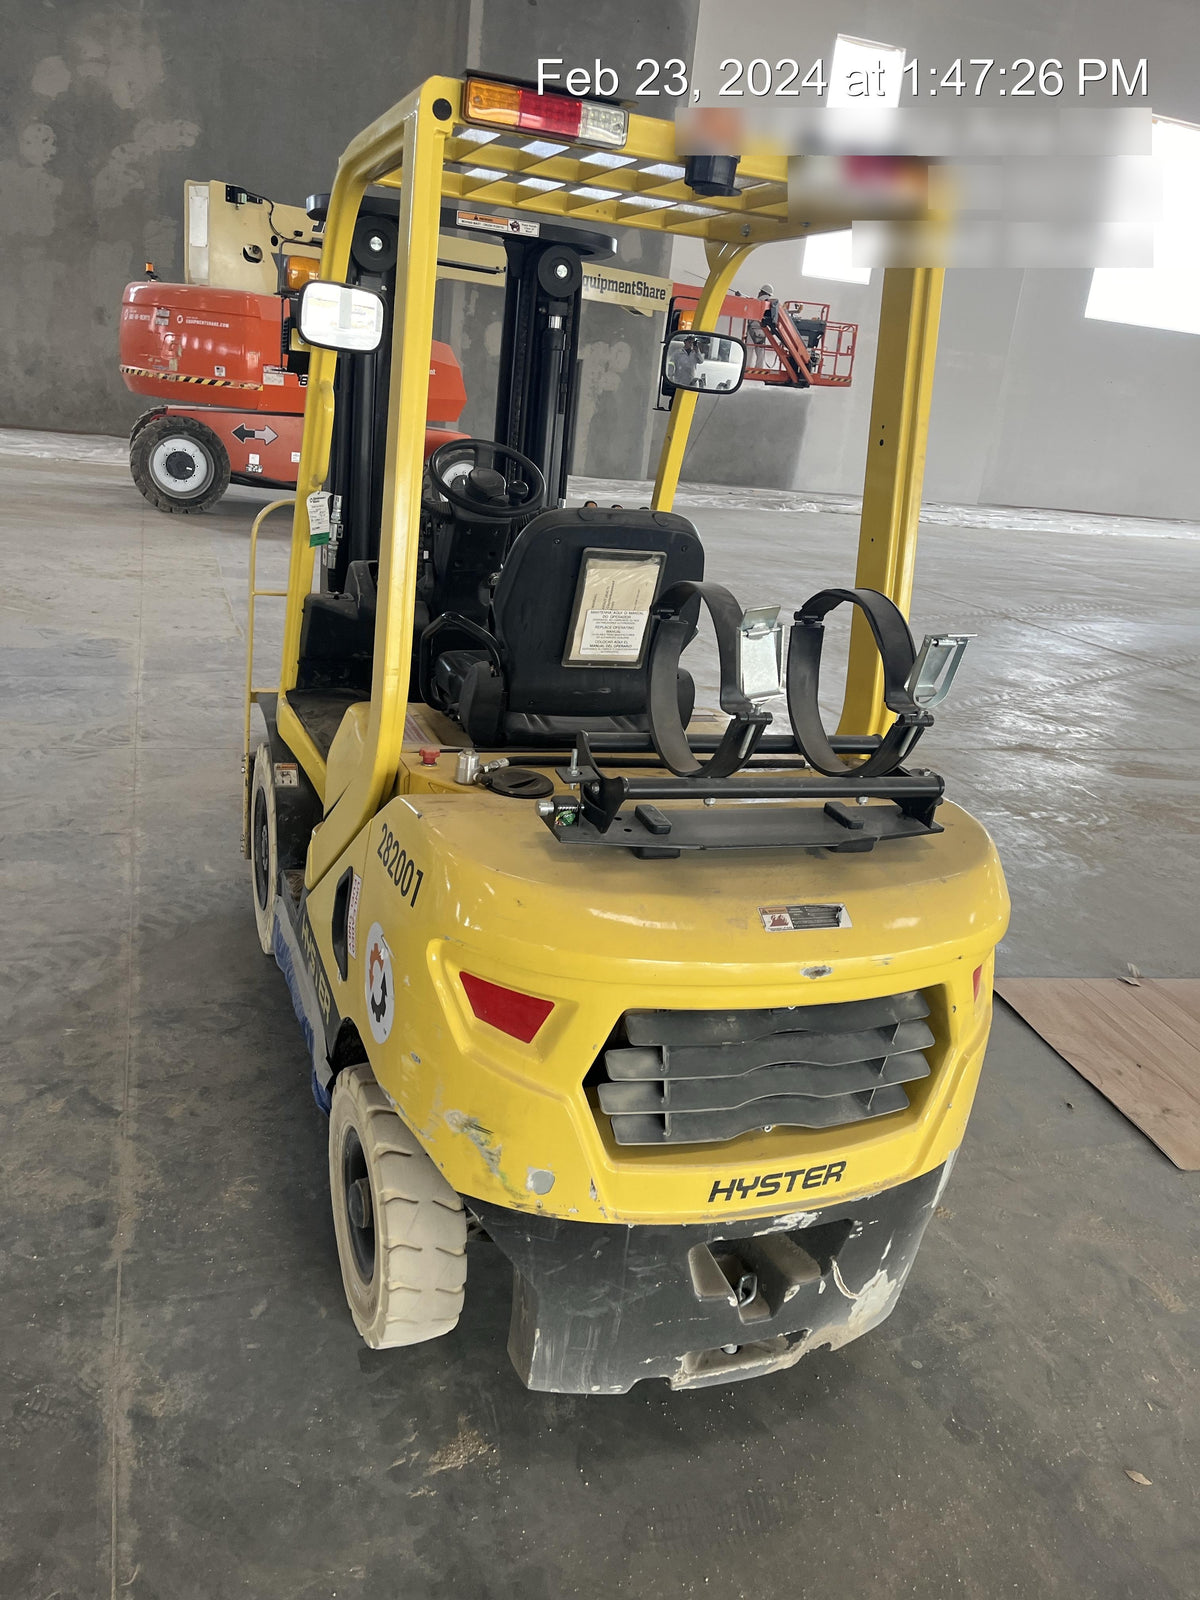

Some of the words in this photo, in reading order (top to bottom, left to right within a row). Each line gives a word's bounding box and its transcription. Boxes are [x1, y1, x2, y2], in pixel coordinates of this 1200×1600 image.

[582, 273, 666, 300] quipmentShare
[377, 823, 424, 908] 282001
[707, 1160, 847, 1203] HYSTER
